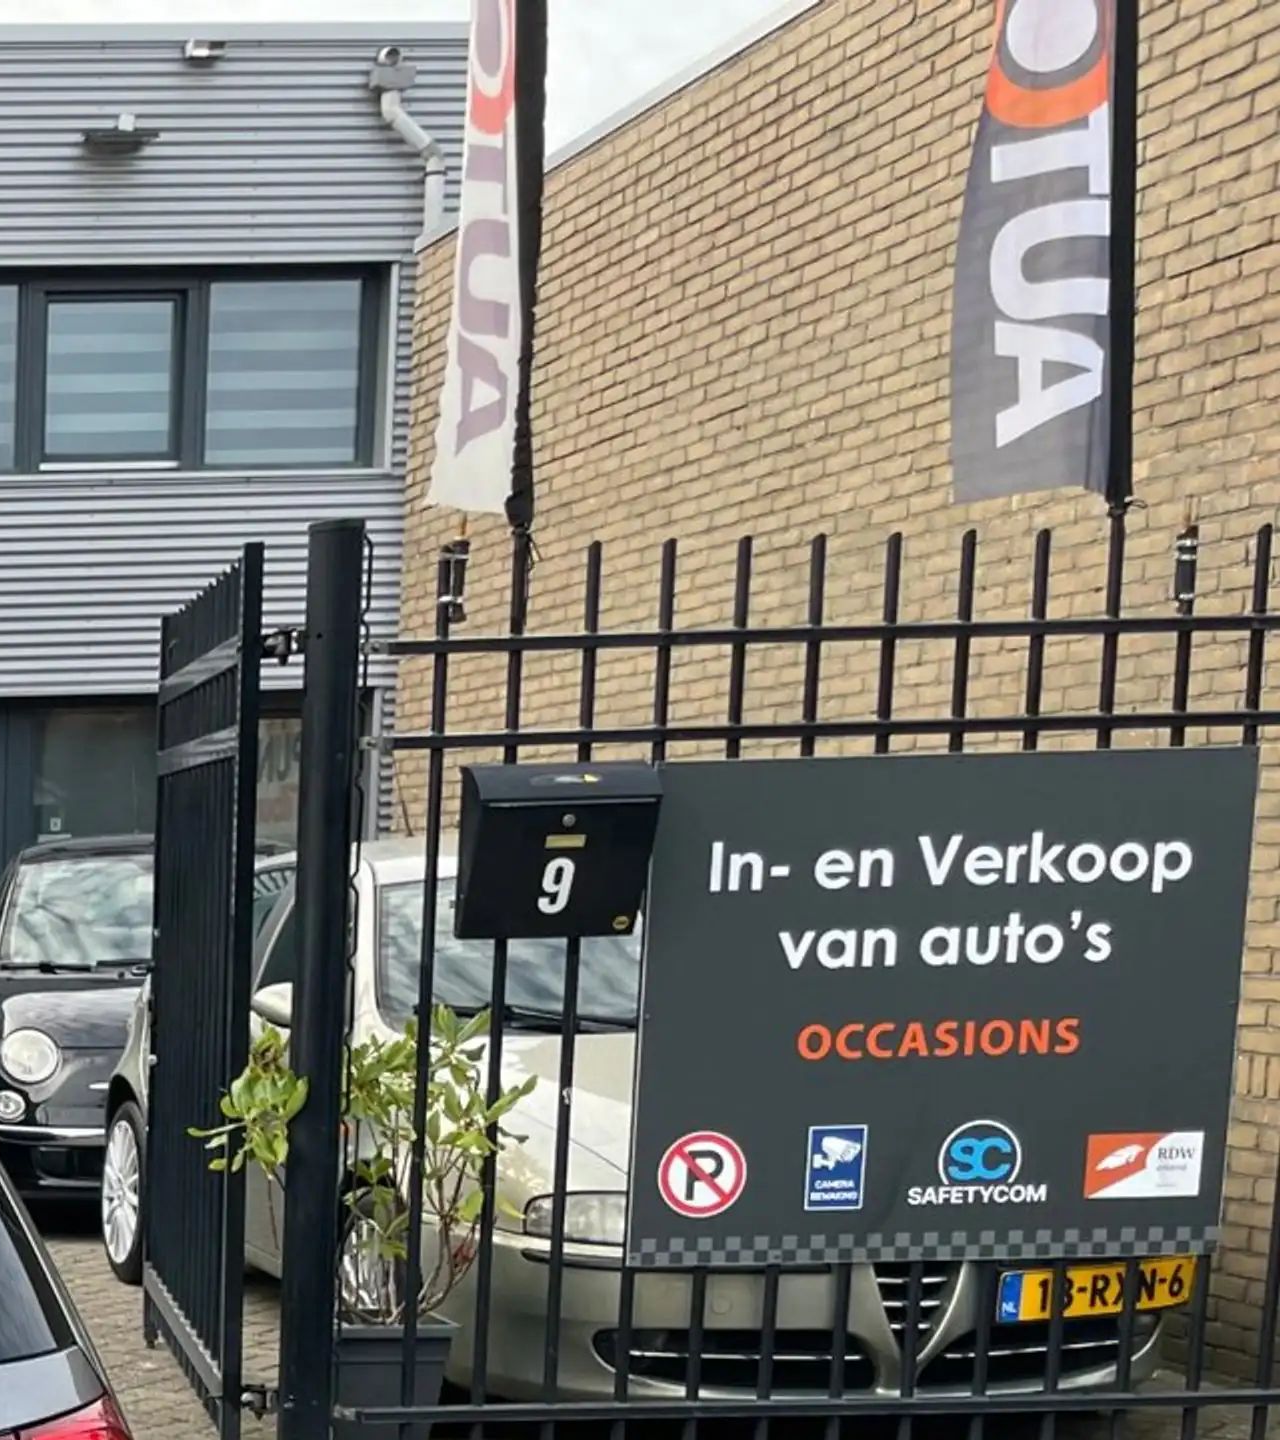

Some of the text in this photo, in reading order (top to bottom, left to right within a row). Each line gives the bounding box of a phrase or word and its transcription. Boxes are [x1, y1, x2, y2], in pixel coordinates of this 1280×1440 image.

[537, 857, 576, 914] 9
[710, 831, 1192, 892] In- en Verkoop
[779, 911, 1111, 968] van auto's
[798, 1018, 1079, 1060] OCCASIONS
[1157, 1146, 1195, 1160] RDW
[908, 1184, 1047, 1205] SAFETYCOM
